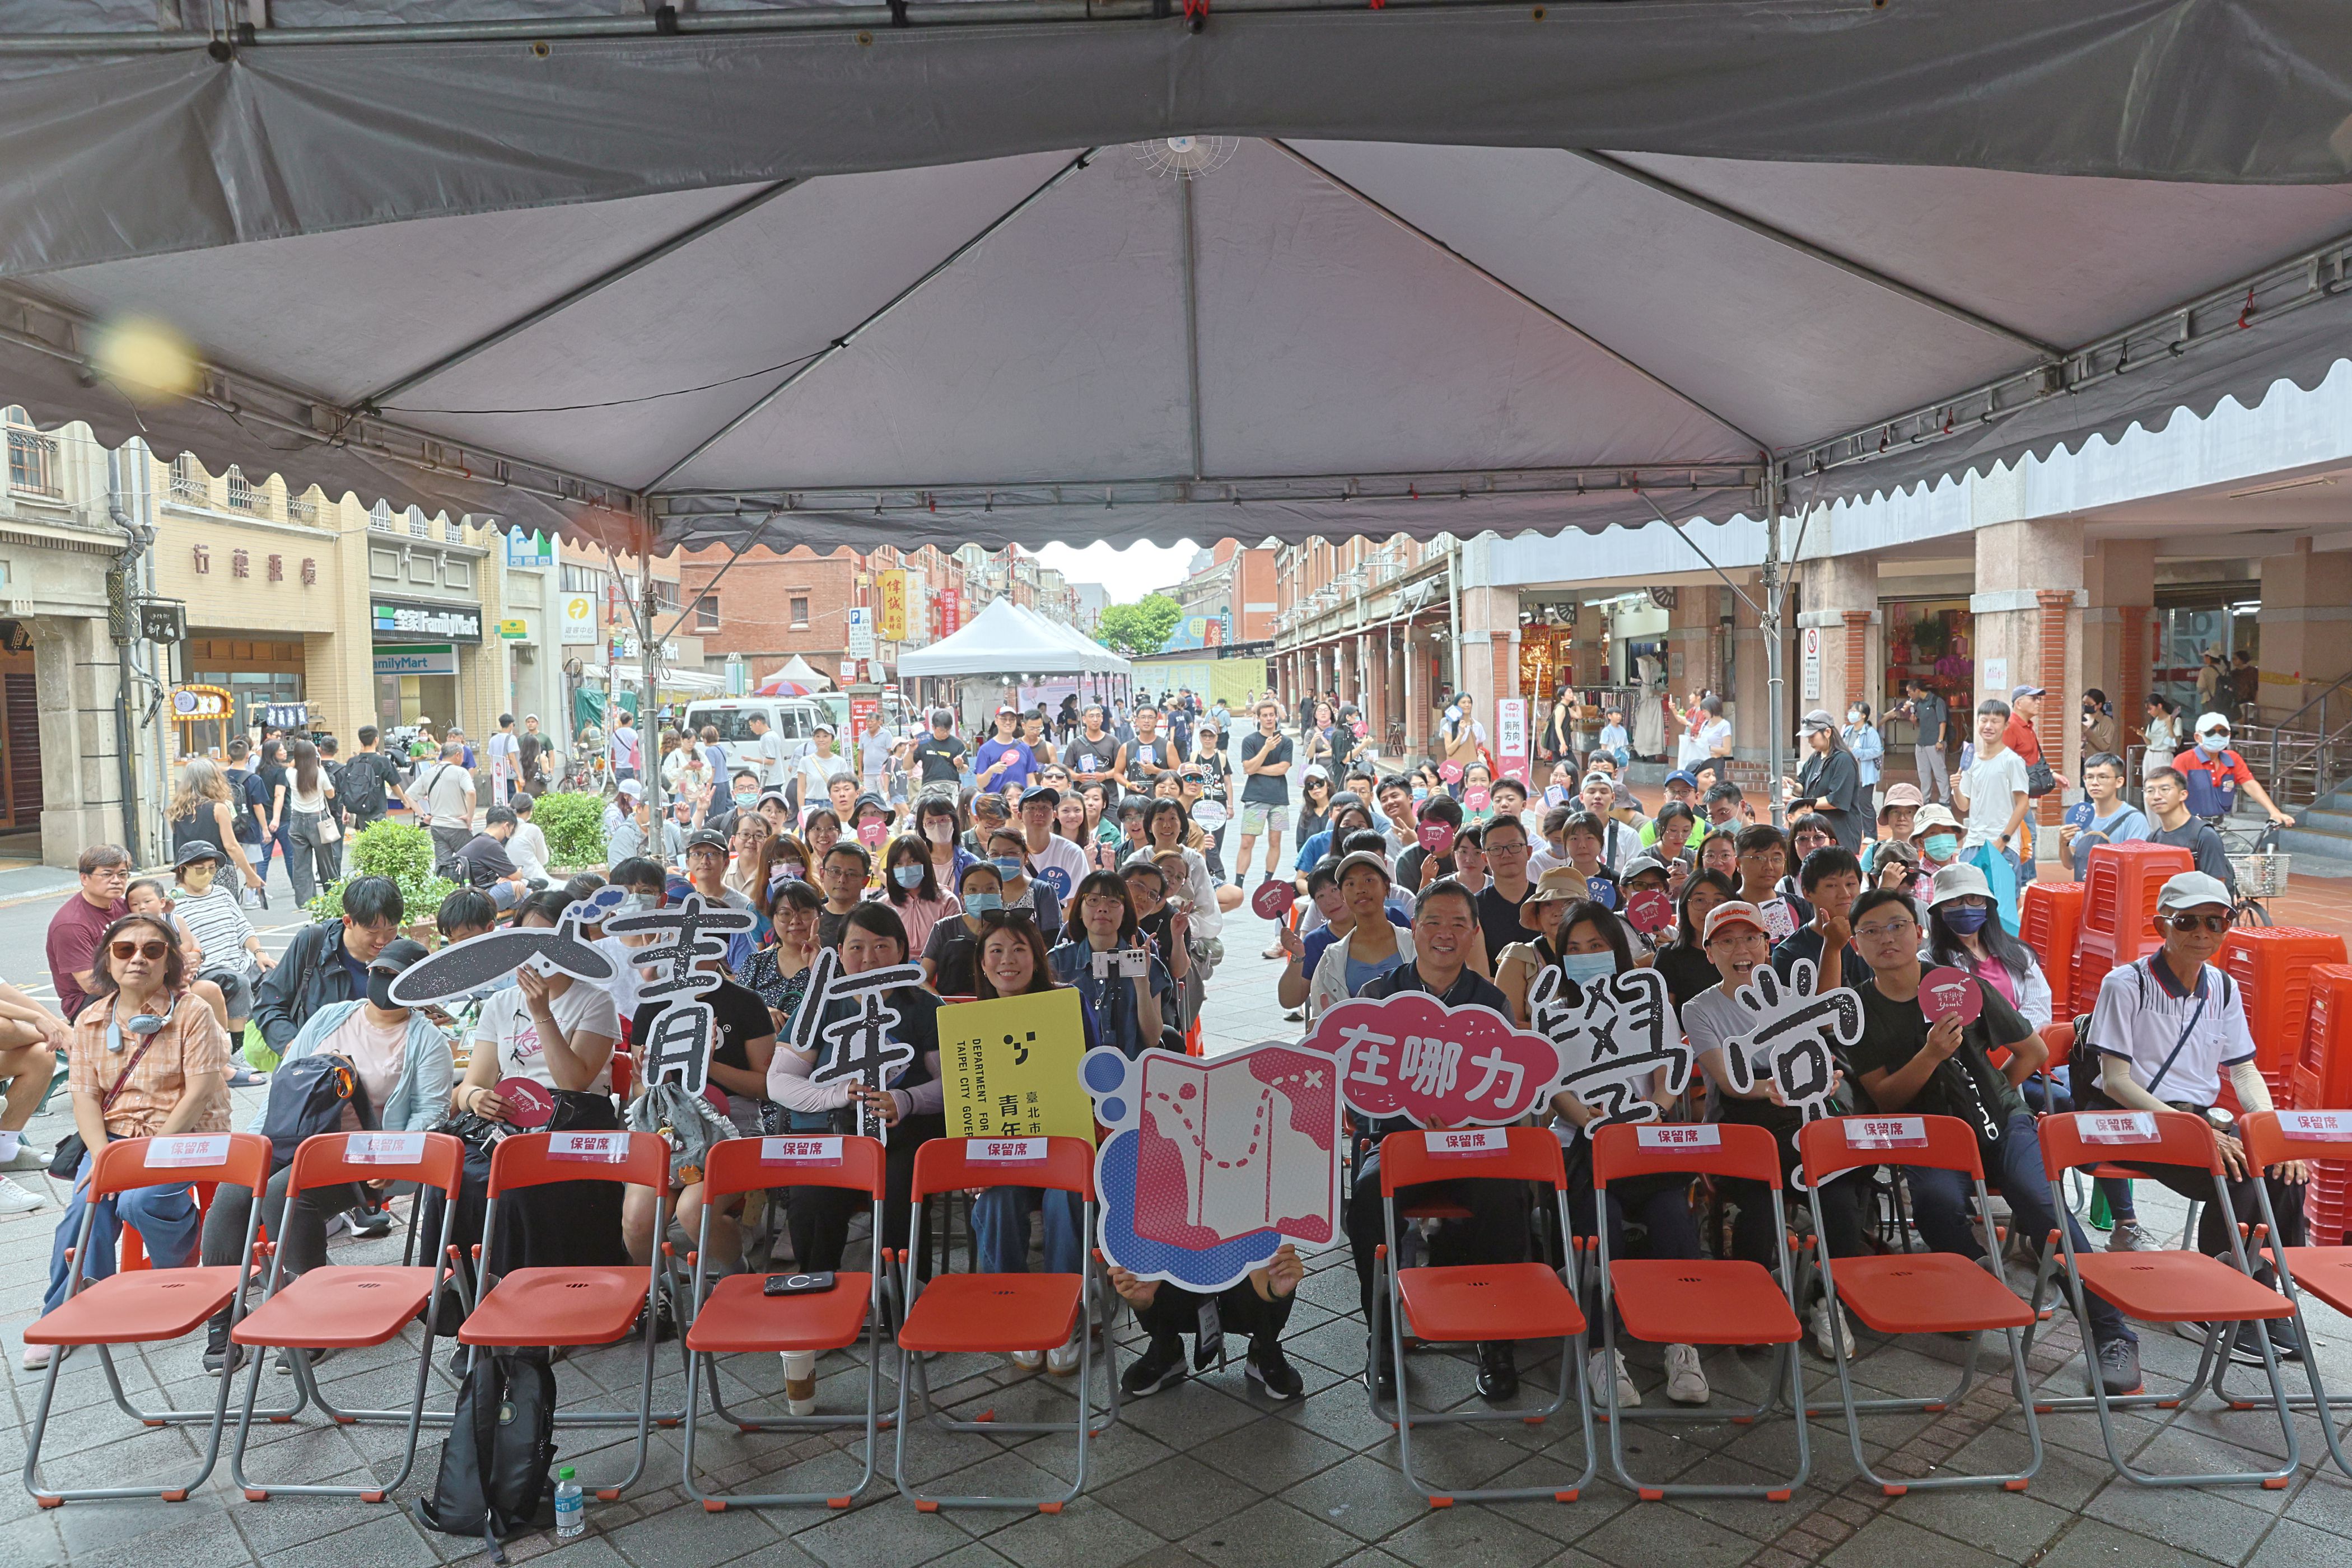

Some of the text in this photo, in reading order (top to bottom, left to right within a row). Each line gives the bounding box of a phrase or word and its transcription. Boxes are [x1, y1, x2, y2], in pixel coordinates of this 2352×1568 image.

[394, 609, 479, 637] 全家 FamilyMart
[852, 612, 859, 623] P
[374, 657, 428, 670] amilyMart
[1505, 721, 1520, 731] 廁所
[1505, 731, 1520, 741] 方向
[607, 898, 753, 1093] 青
[1935, 991, 1964, 1001] 青年學堂
[796, 951, 921, 1137] 年
[957, 1040, 968, 1071] TAIPEI
[1338, 1023, 1525, 1109] 在哪力
[960, 1077, 970, 1099] CITY
[972, 1038, 989, 1131] DEPARTMENT FOR
[998, 1094, 1023, 1136] 青年
[1026, 1091, 1040, 1134] 臺北市
[1864, 1122, 1904, 1136] 保留席
[2095, 1118, 2135, 1131] 保留席
[2298, 1116, 2339, 1130] 保留席
[571, 1137, 609, 1151] 保留席
[1445, 1133, 1486, 1148] 保留席
[1657, 1130, 1699, 1144] 保留席
[171, 1141, 211, 1155] 保留席
[367, 1138, 405, 1152] 保留席
[783, 1142, 823, 1155] 保留席
[987, 1142, 1028, 1156] 保留席
